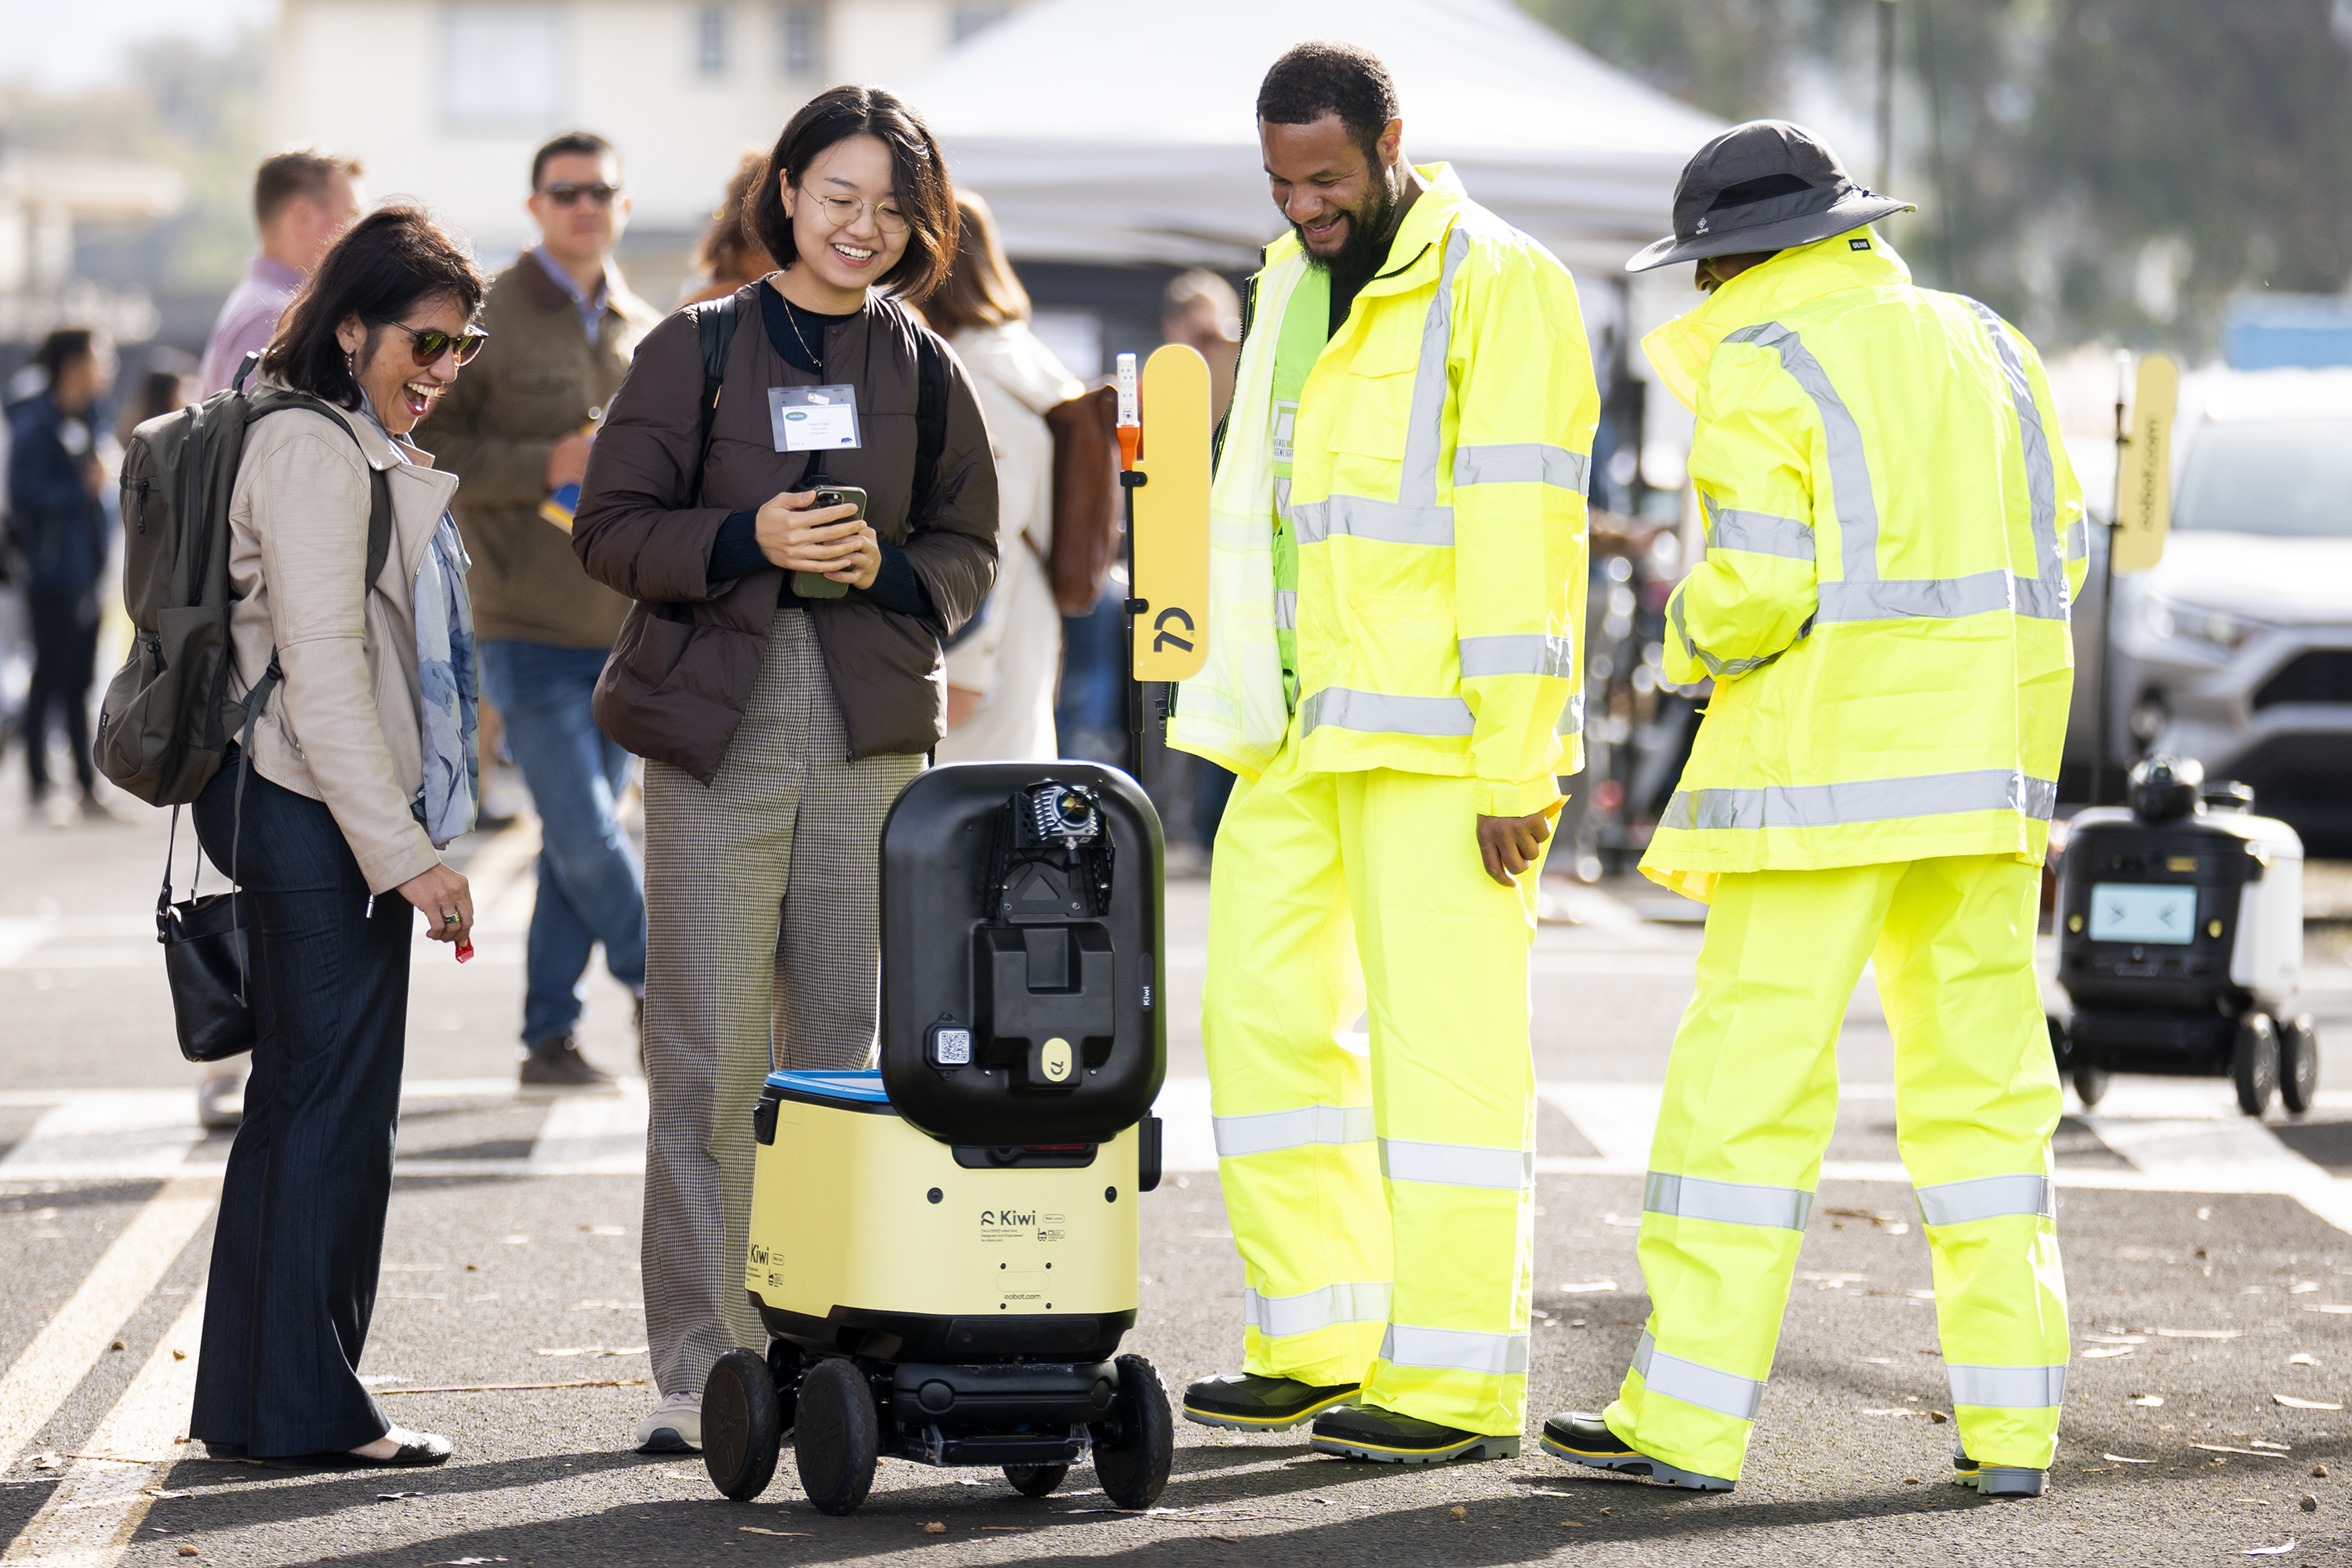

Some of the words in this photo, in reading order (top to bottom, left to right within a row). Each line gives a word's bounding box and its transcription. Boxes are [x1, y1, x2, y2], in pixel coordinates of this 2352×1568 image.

[1272, 438, 1287, 448] VENUE
[1000, 1210, 1036, 1225] Kiwi
[750, 1243, 769, 1265] Kiwi
